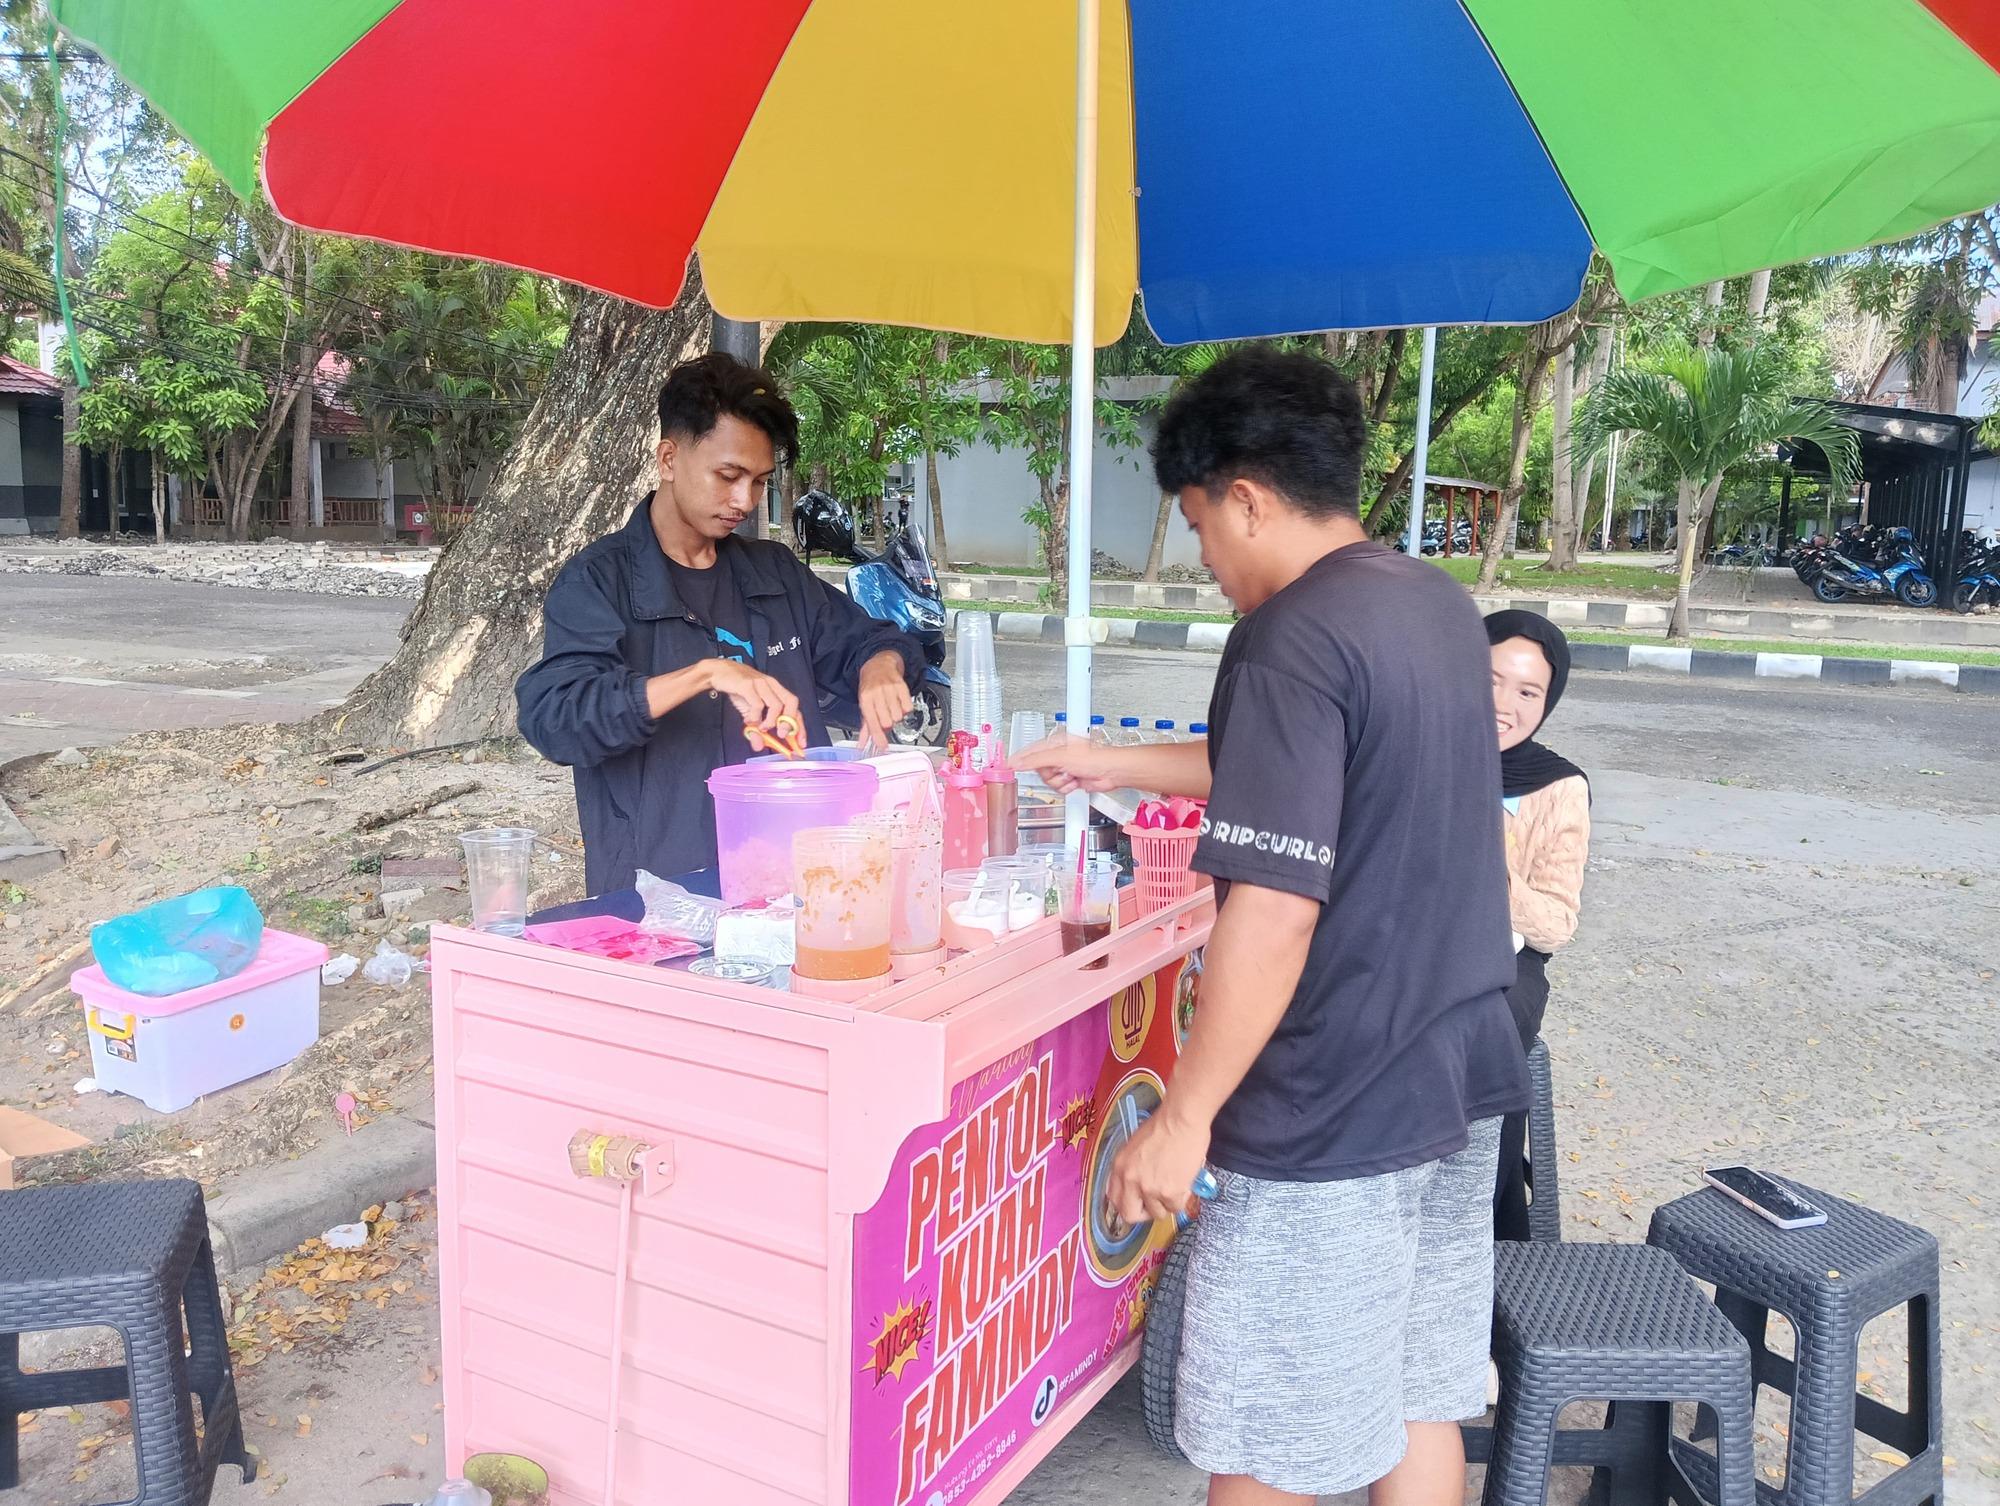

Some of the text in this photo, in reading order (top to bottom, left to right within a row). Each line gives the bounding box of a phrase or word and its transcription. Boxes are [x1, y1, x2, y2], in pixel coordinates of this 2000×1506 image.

[1126, 1035, 1141, 1049] HALAL
[904, 1049, 1057, 1282] PENTOL
[934, 1159, 1047, 1368] KUAH
[875, 1301, 932, 1385] NICE!
[895, 1223, 1082, 1506] FAMINDY
